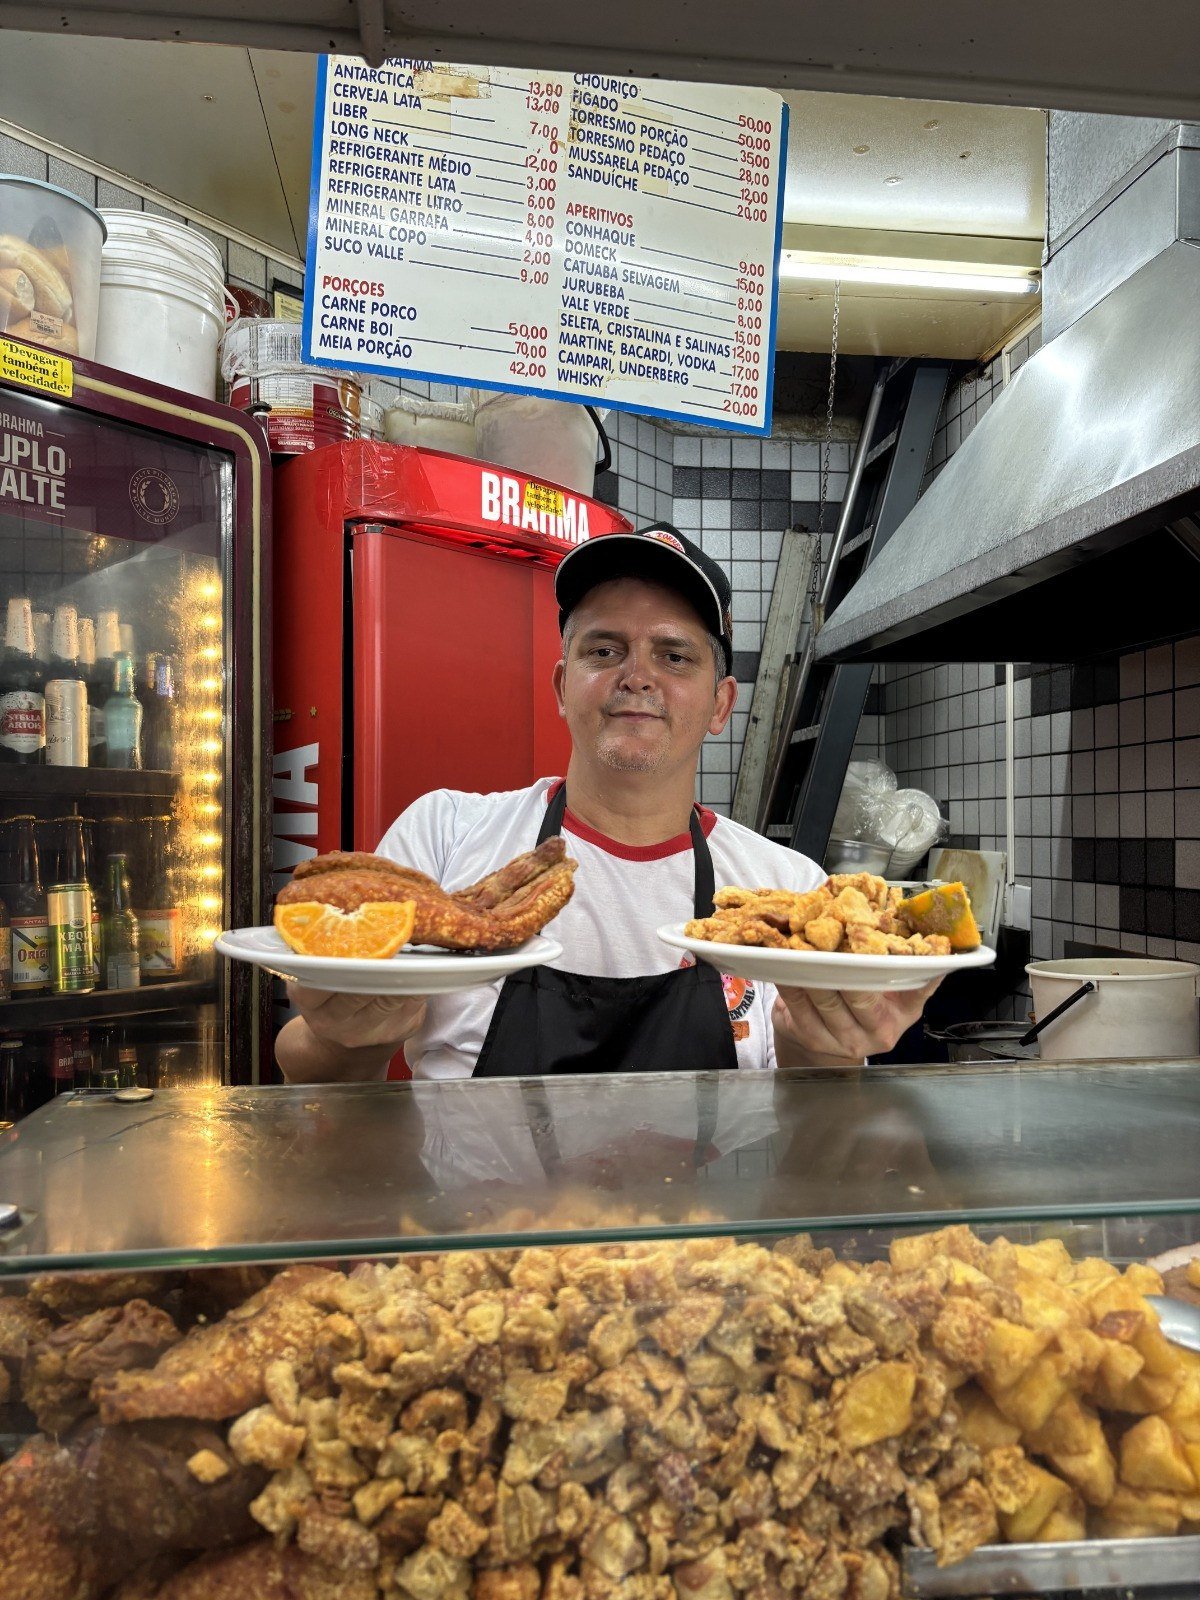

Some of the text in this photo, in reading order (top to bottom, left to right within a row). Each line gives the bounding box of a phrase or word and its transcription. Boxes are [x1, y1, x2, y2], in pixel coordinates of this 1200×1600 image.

[332, 101, 368, 120] LIBER
[333, 83, 558, 140] CERVEJA LATA 7,00
[334, 64, 560, 114] ANTARCTICA 13,00
[528, 81, 563, 97] 13,00
[573, 73, 772, 134] CHOURIÇO 50,00
[331, 120, 558, 173] LONG NECK 12,00
[570, 126, 769, 187] TORRESMO PEDAÇO 28,00
[571, 108, 770, 169] TORRESMO PORÇÃO 35,00
[738, 133, 771, 152] 50,00
[329, 159, 555, 210] REFRIGERANTE LATA 6,00
[330, 140, 556, 191] REFRIGERANTE MÉDIO 3,00
[569, 146, 768, 205] MUSSARELA PEDAÇO 12,00
[328, 178, 555, 229] REFRIGERANTE LITRO 8,00
[566, 202, 634, 228] APERITIVOS
[567, 164, 767, 223] SANDUÍCHE 20,00
[325, 216, 551, 265] MINERAL COPO 2,00
[326, 197, 553, 247] MINERAL GARRAFA 4,00
[324, 236, 549, 285] SUCO VALLE 9,00
[565, 220, 765, 277] CONHAQUE 9,00
[565, 239, 764, 296] DOMECK 15,00
[322, 275, 385, 297] PORÇOES
[562, 276, 762, 329] JURUBEBA 8,00
[563, 258, 762, 312] CATUABA SELVAGEM 8,00
[320, 314, 547, 359] CARNE BOI 70,00
[321, 295, 366, 314] CARNE
[371, 302, 417, 321] PORCO
[508, 322, 548, 340] 50,00
[560, 313, 760, 364] SELETA, CRISTALINA E SALINAS 12,00
[561, 294, 761, 347] VALE VERDE 15,00
[3, 354, 50, 376] também
[52, 366, 59, 379] é
[319, 333, 547, 378] MEIA PORÇÃO 42,00
[558, 350, 758, 399] CAMPARI, UNDERBERG 17,00
[559, 331, 759, 382] MARTINE, BACARDI, VODKA 17,00
[557, 367, 758, 416] WHISKY 20,00
[7, 712, 41, 722] STELLA
[8, 721, 42, 730] ARTOIS
[729, 989, 756, 1021] ENTRAL
